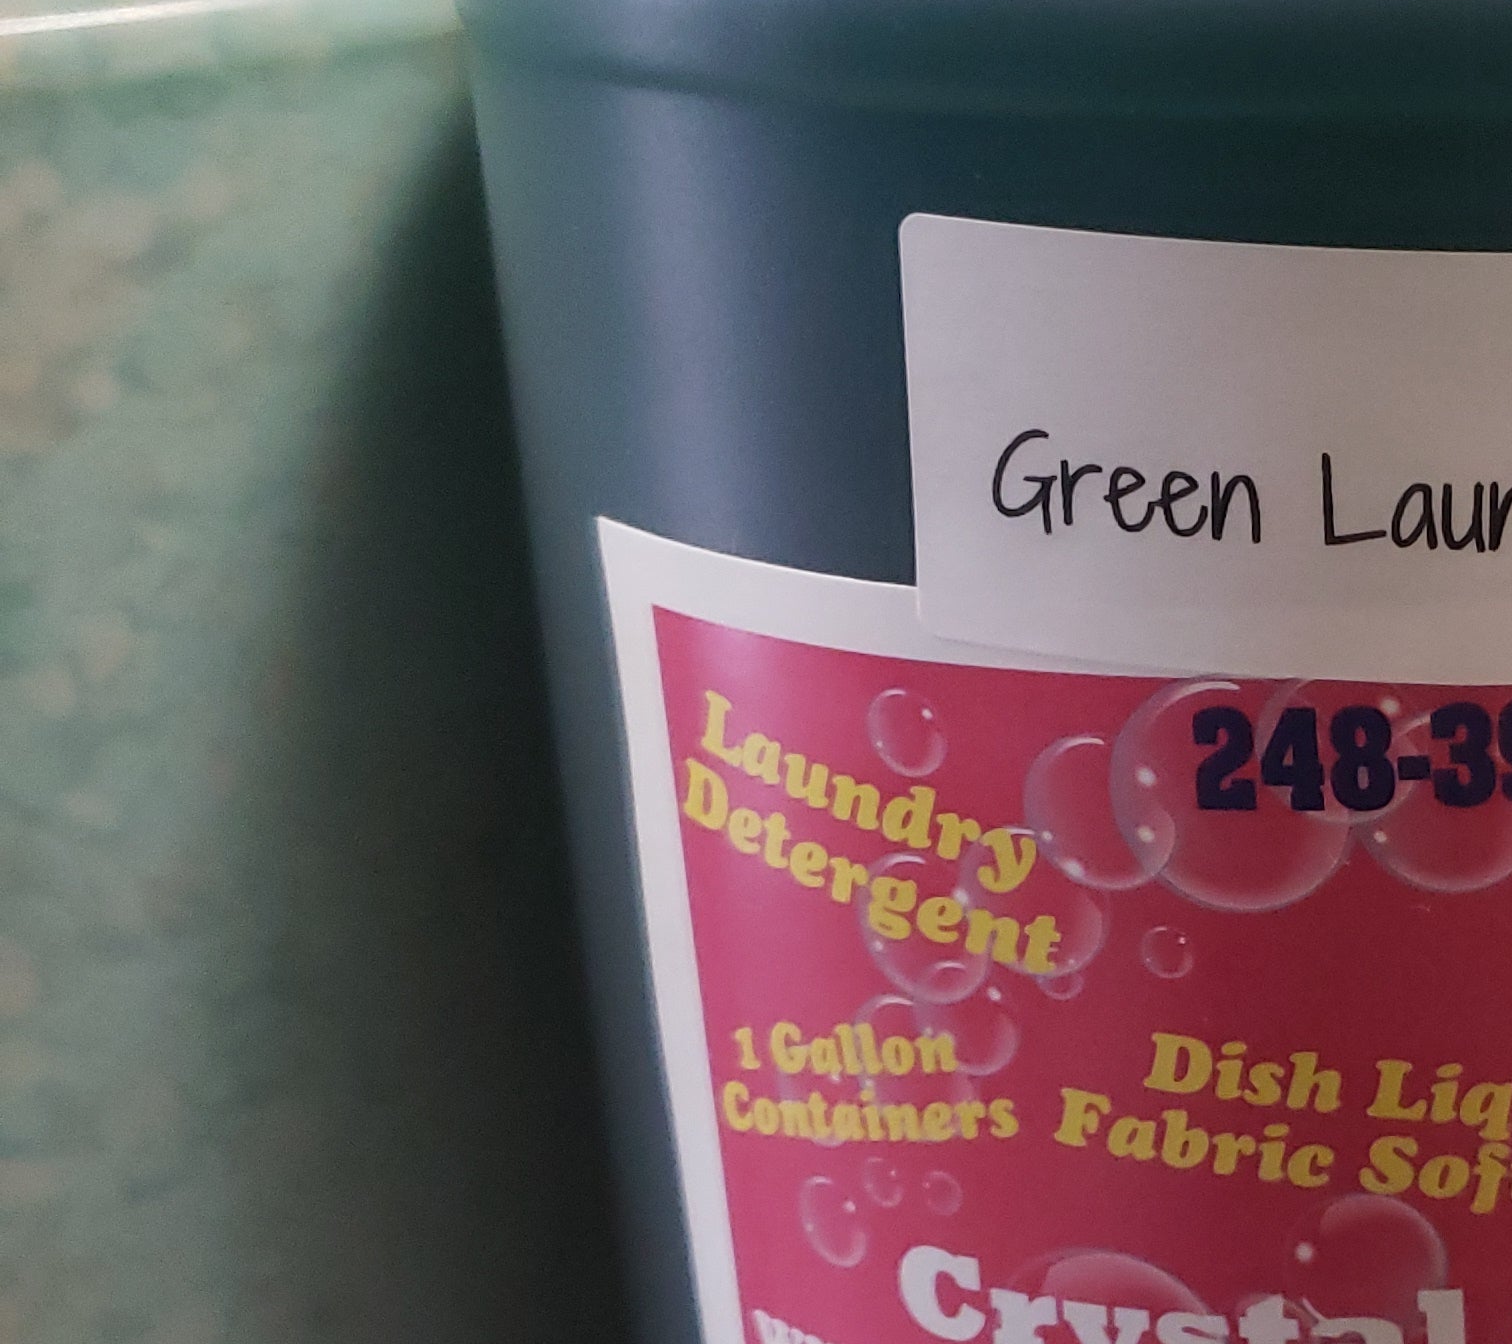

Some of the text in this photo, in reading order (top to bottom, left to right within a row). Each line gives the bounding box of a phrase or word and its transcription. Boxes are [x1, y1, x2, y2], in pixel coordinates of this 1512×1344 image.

[992, 428, 1261, 544] Green
[700, 689, 1038, 893] Laundry
[683, 757, 1062, 975] Detergent
[733, 1021, 959, 1076] 1 Gallon
[1143, 1032, 1342, 1114] Dish
[722, 1080, 1020, 1142] Containers
[1053, 1087, 1335, 1187] Fabric
